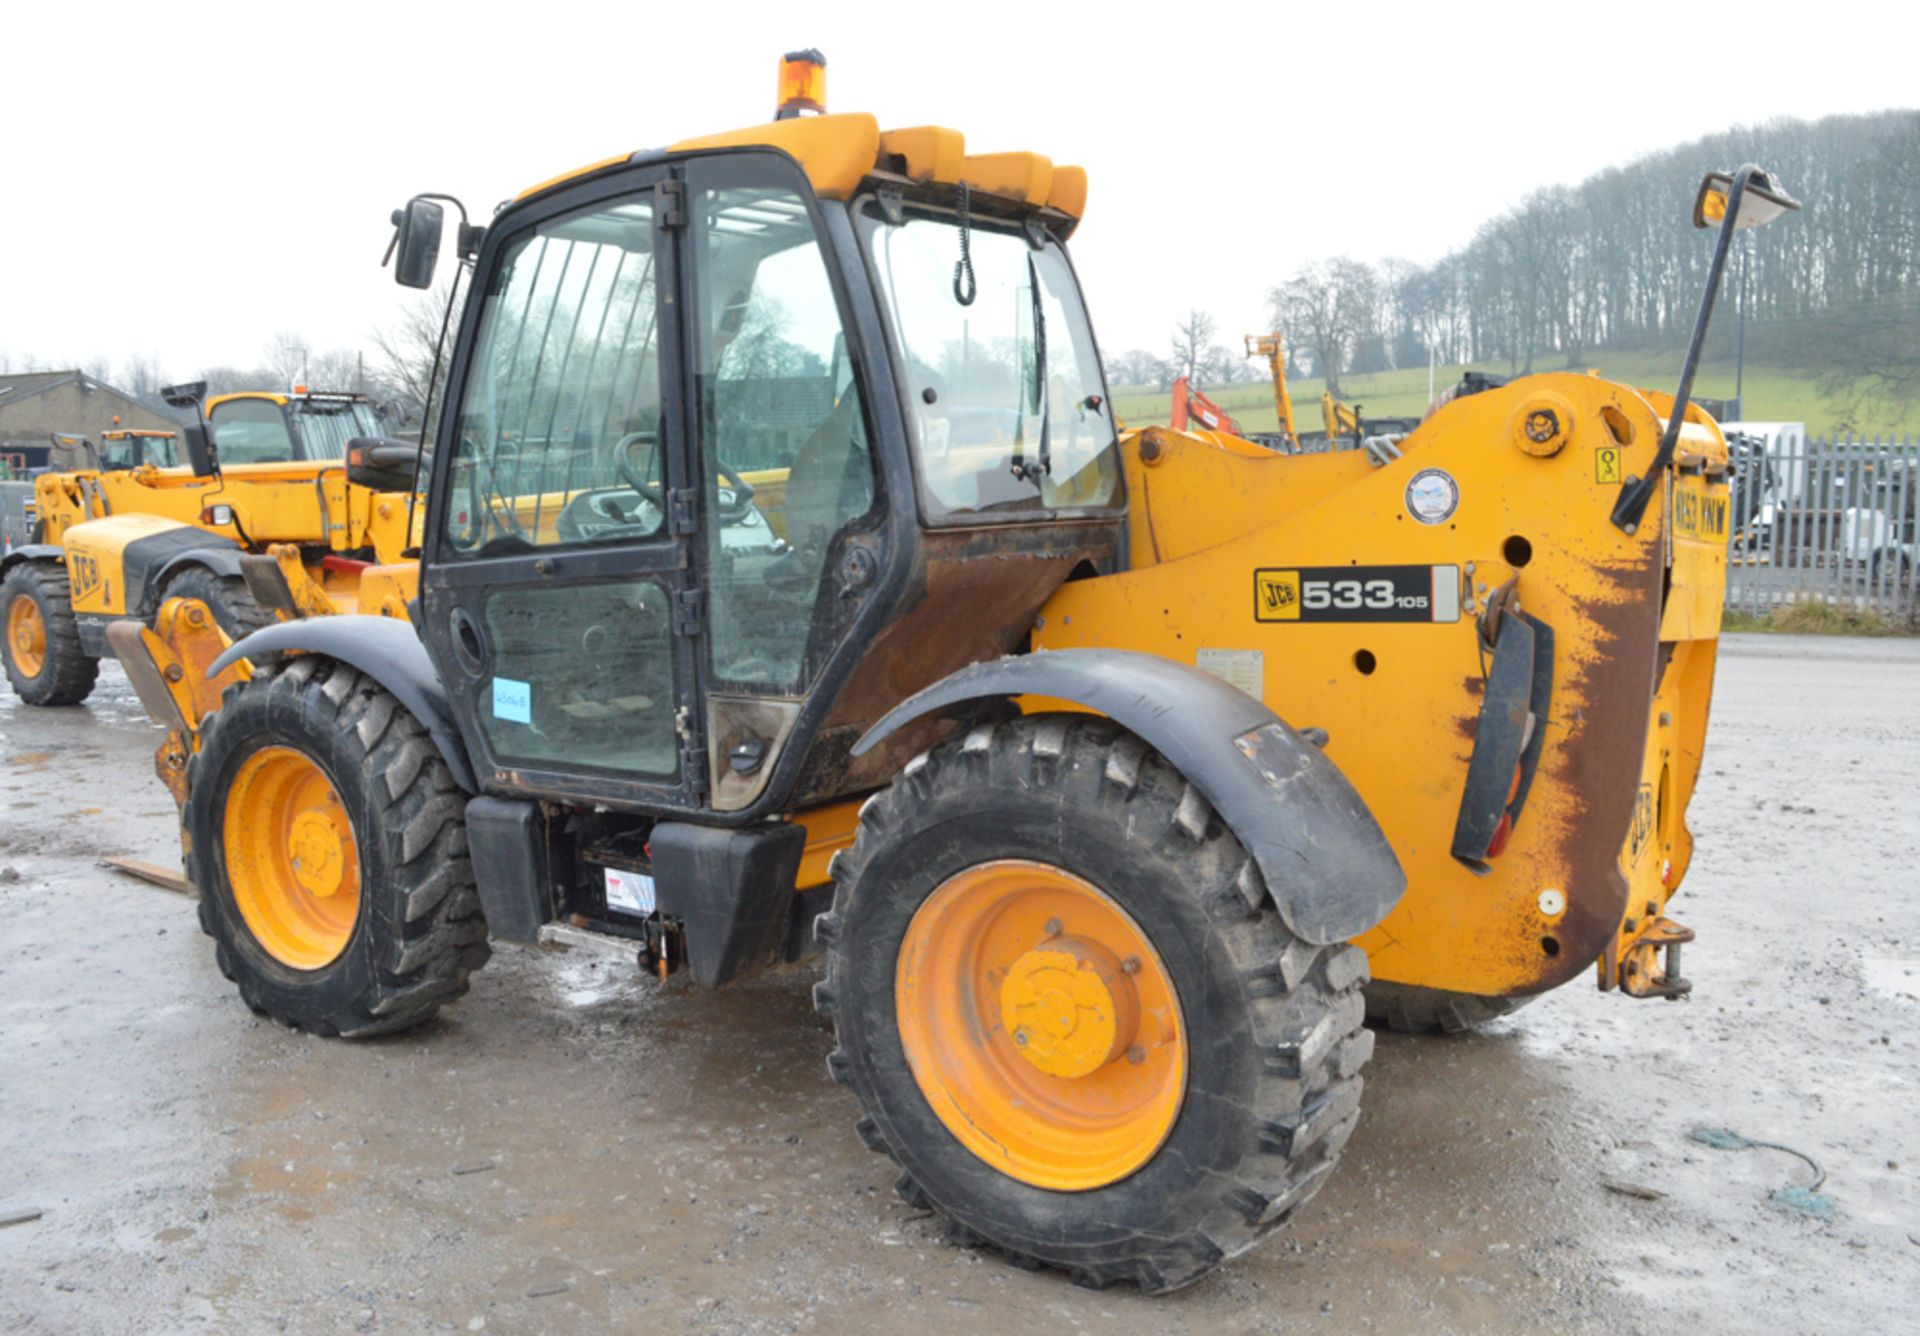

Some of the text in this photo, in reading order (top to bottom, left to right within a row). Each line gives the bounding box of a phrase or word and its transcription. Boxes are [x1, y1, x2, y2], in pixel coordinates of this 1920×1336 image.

[73, 555, 97, 597] JCB
[1266, 582, 1295, 608] JCB
[1303, 580, 1428, 609] 533 105
